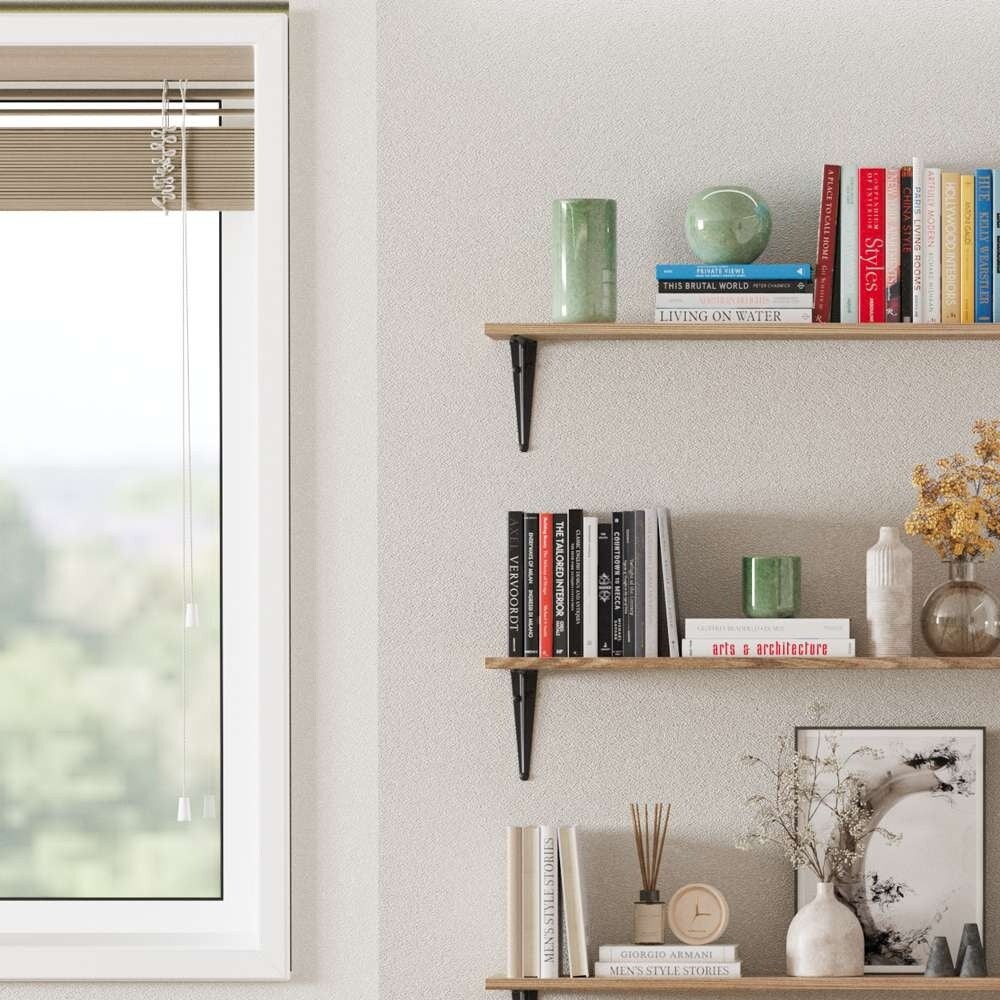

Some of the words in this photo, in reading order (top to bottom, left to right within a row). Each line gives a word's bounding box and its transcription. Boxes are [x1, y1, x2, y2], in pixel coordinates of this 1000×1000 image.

[826, 177, 834, 200] PLACE
[888, 174, 898, 194] NEW
[979, 176, 990, 201] HUE
[825, 202, 832, 214] TO
[904, 186, 912, 220] CHINA
[823, 215, 831, 235] CALL
[944, 182, 956, 249] HOLLYWOOD
[904, 224, 912, 252] STYLE
[927, 209, 935, 247] MODERN
[821, 237, 830, 260] HOME
[860, 237, 884, 291] Styles
[663, 282, 682, 290] THIS
[685, 282, 717, 290] BRUTAL
[719, 282, 749, 290] WORLD
[660, 311, 708, 322] LIVING
[712, 311, 732, 322] ON
[736, 311, 782, 322] WATER
[556, 522, 564, 538] THE
[556, 539, 564, 578] TAILORED
[510, 555, 519, 632] VERVOORDT
[556, 578, 564, 617] INTERIOR
[712, 642, 736, 656] arts
[756, 642, 828, 656] architecture
[544, 837, 554, 886] STORIES
[544, 888, 554, 924] STYLE
[620, 951, 666, 959] GIORGIO
[670, 951, 712, 959] ARMANI
[647, 966, 681, 976] STYLE
[684, 966, 729, 976] STORIES
